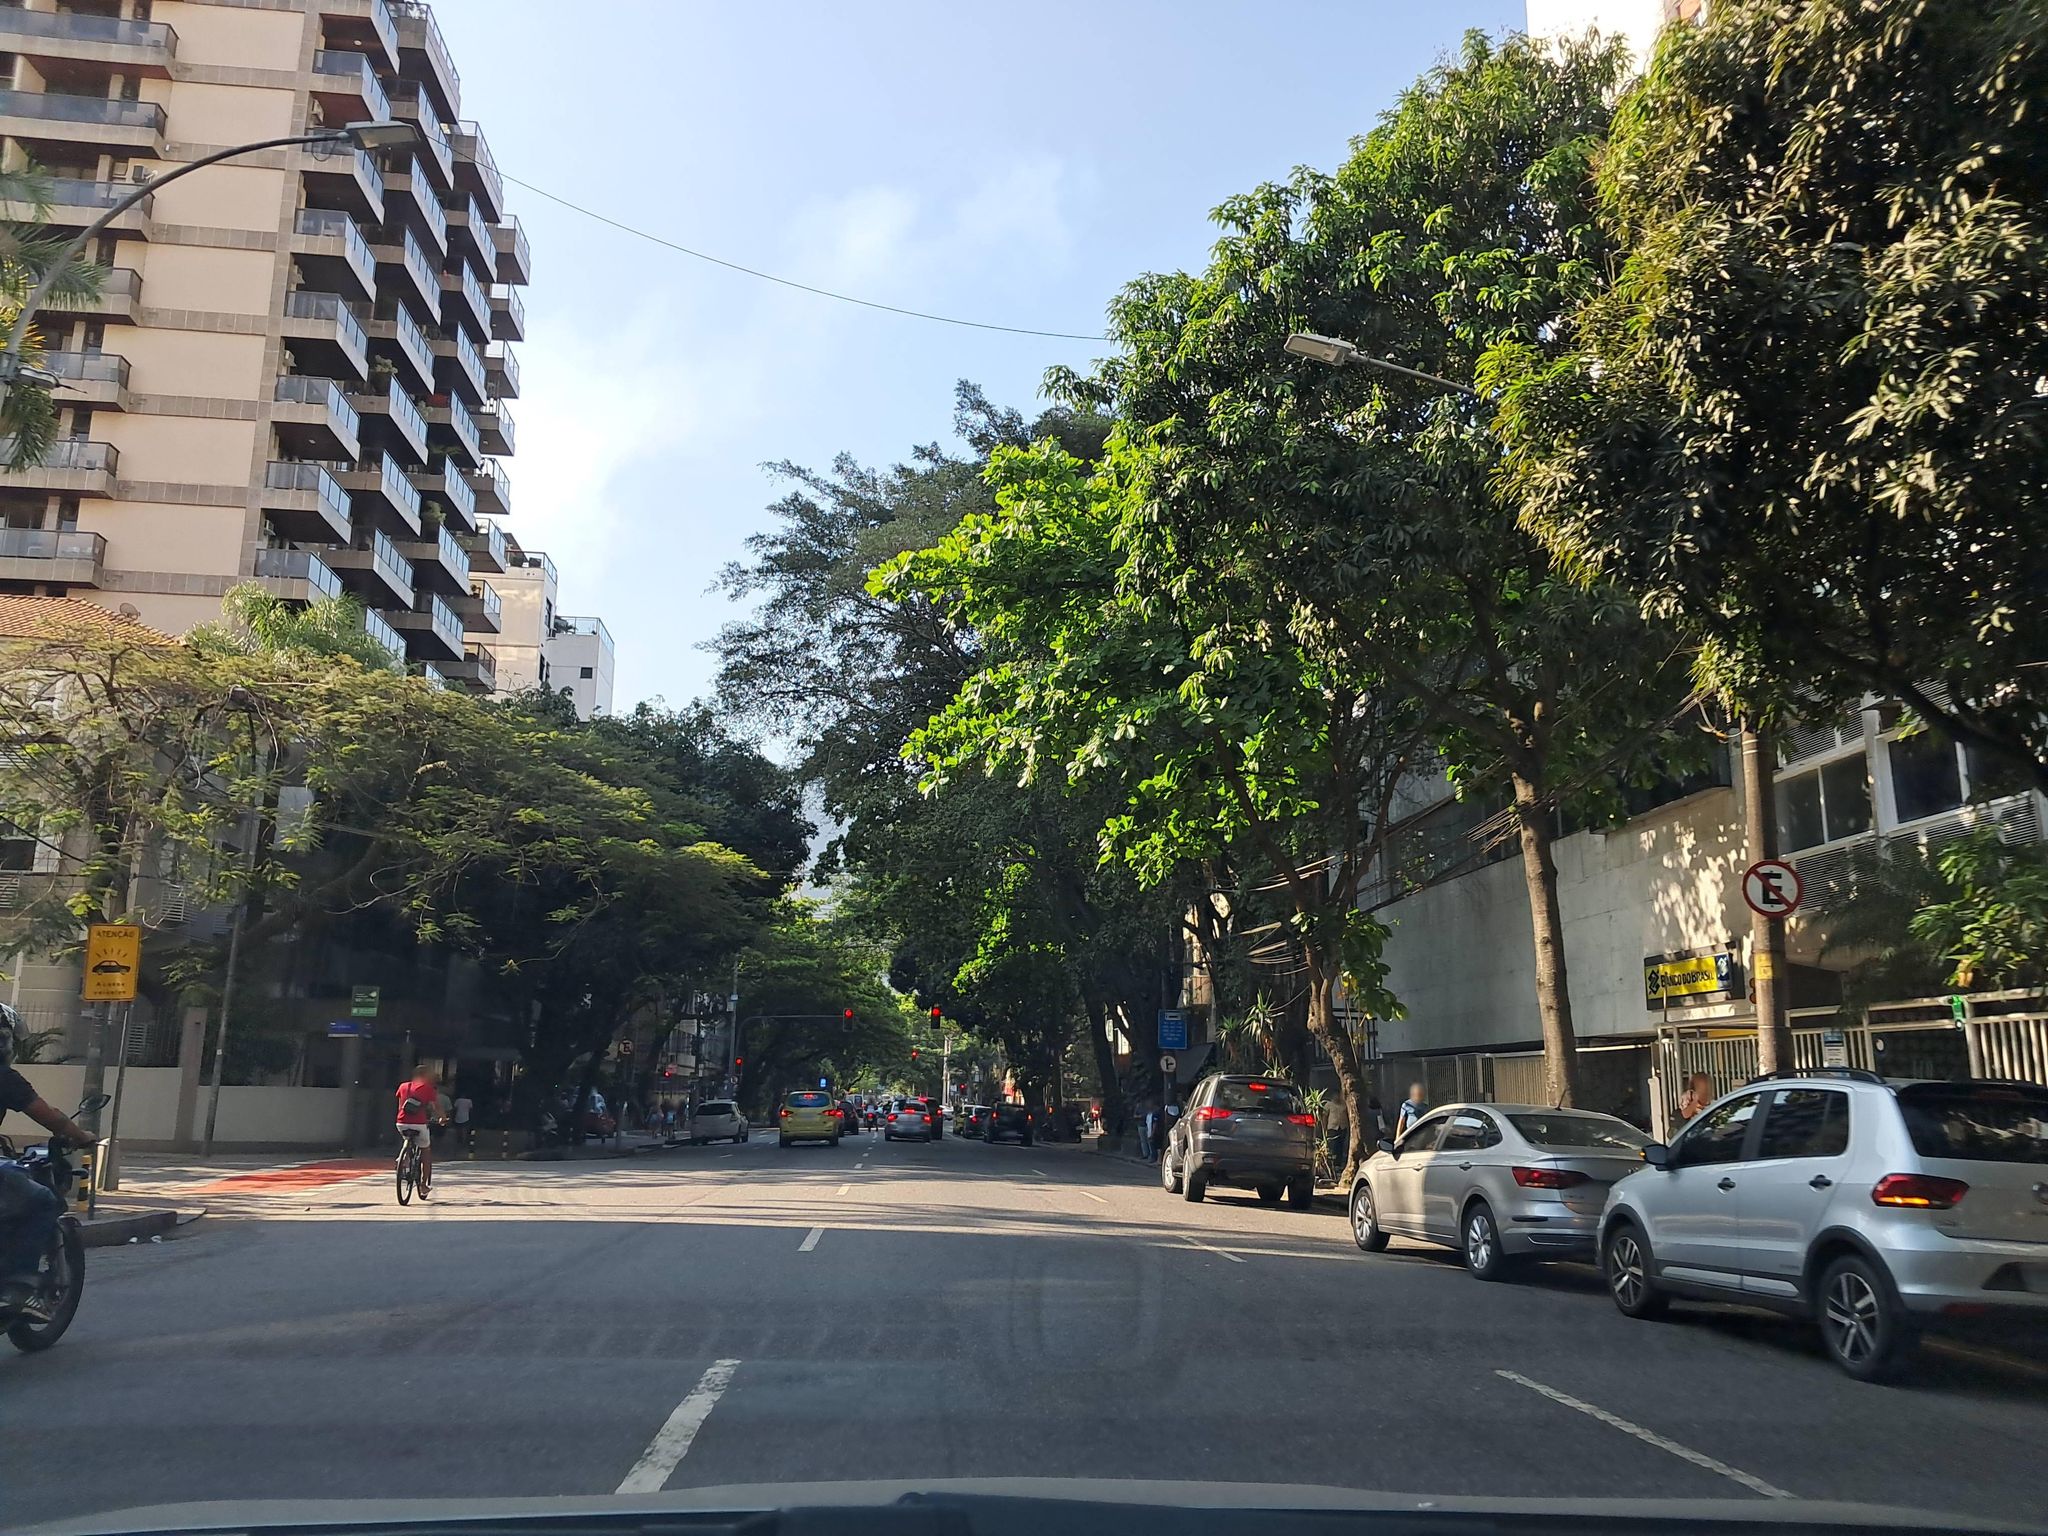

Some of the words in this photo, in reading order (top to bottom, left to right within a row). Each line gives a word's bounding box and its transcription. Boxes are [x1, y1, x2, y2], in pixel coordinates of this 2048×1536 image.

[1762, 873, 1782, 905] E
[96, 929, 135, 939] ATENÇÃO
[1660, 973, 1682, 988] BANCO
[1682, 973, 1691, 985] DO
[1691, 970, 1714, 983] BRASIL
